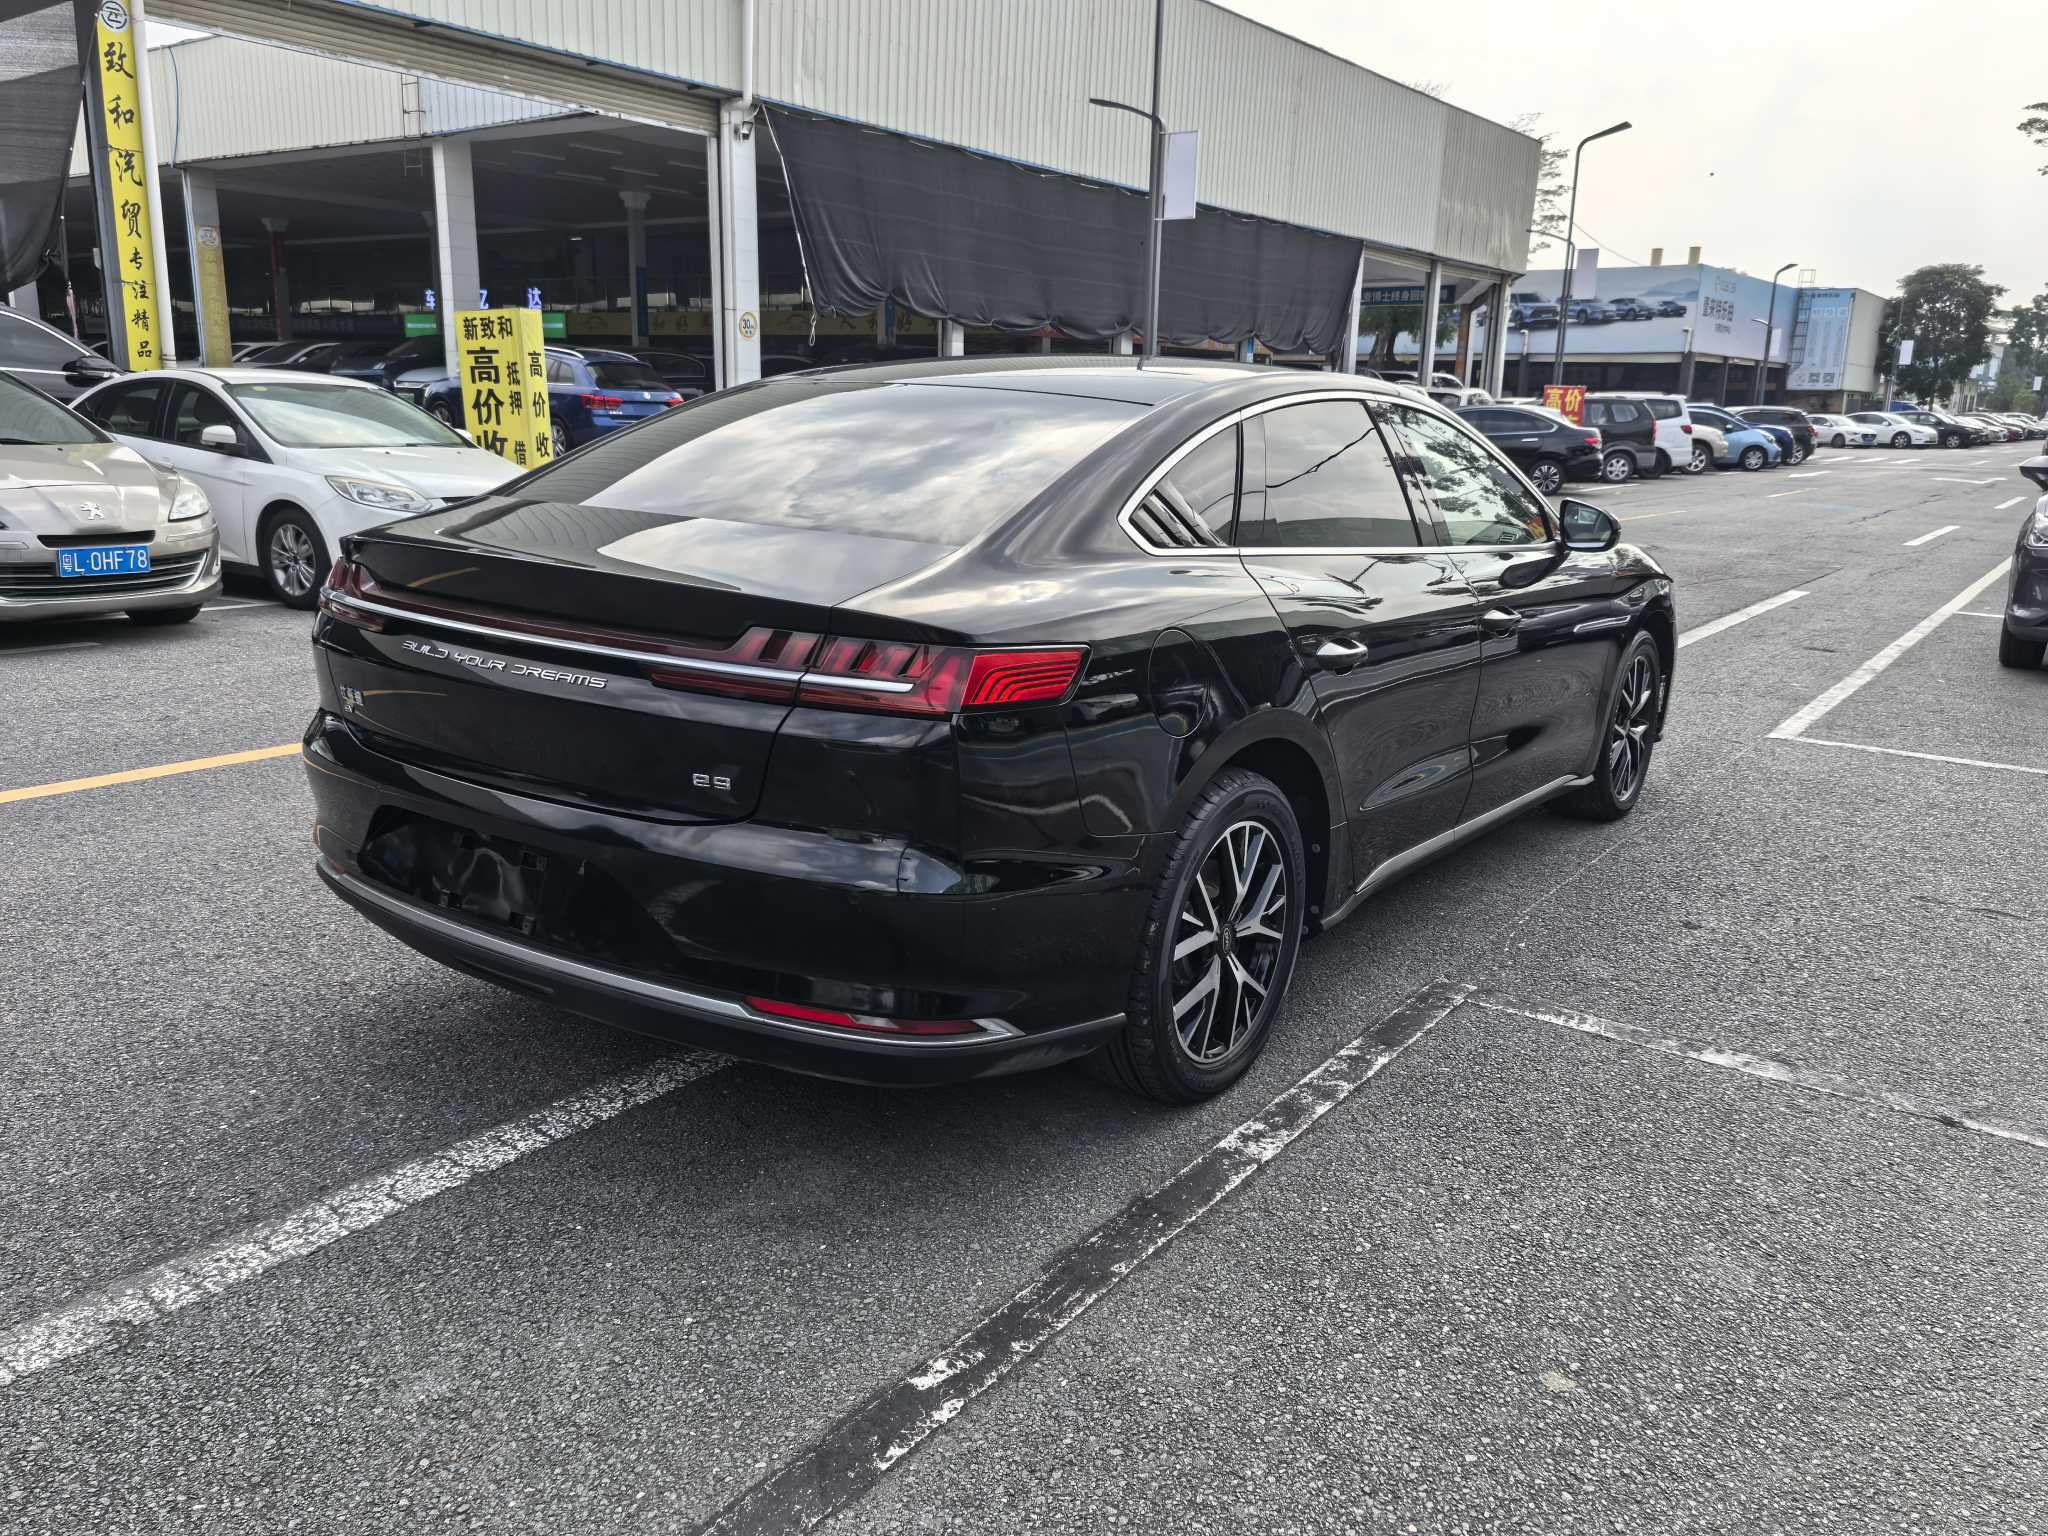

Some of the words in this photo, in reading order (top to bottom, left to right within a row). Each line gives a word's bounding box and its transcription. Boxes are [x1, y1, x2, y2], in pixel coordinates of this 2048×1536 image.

[103, 41, 153, 371] 致和汽贸专注精品
[463, 315, 513, 341] 新致和
[466, 346, 508, 457] 高价收
[527, 350, 550, 458] 高价收
[1545, 388, 1582, 412] 高价
[514, 440, 527, 465] 借
[403, 640, 449, 660] BUILD
[454, 651, 506, 672] YOUR
[511, 664, 608, 689] DREAMS
